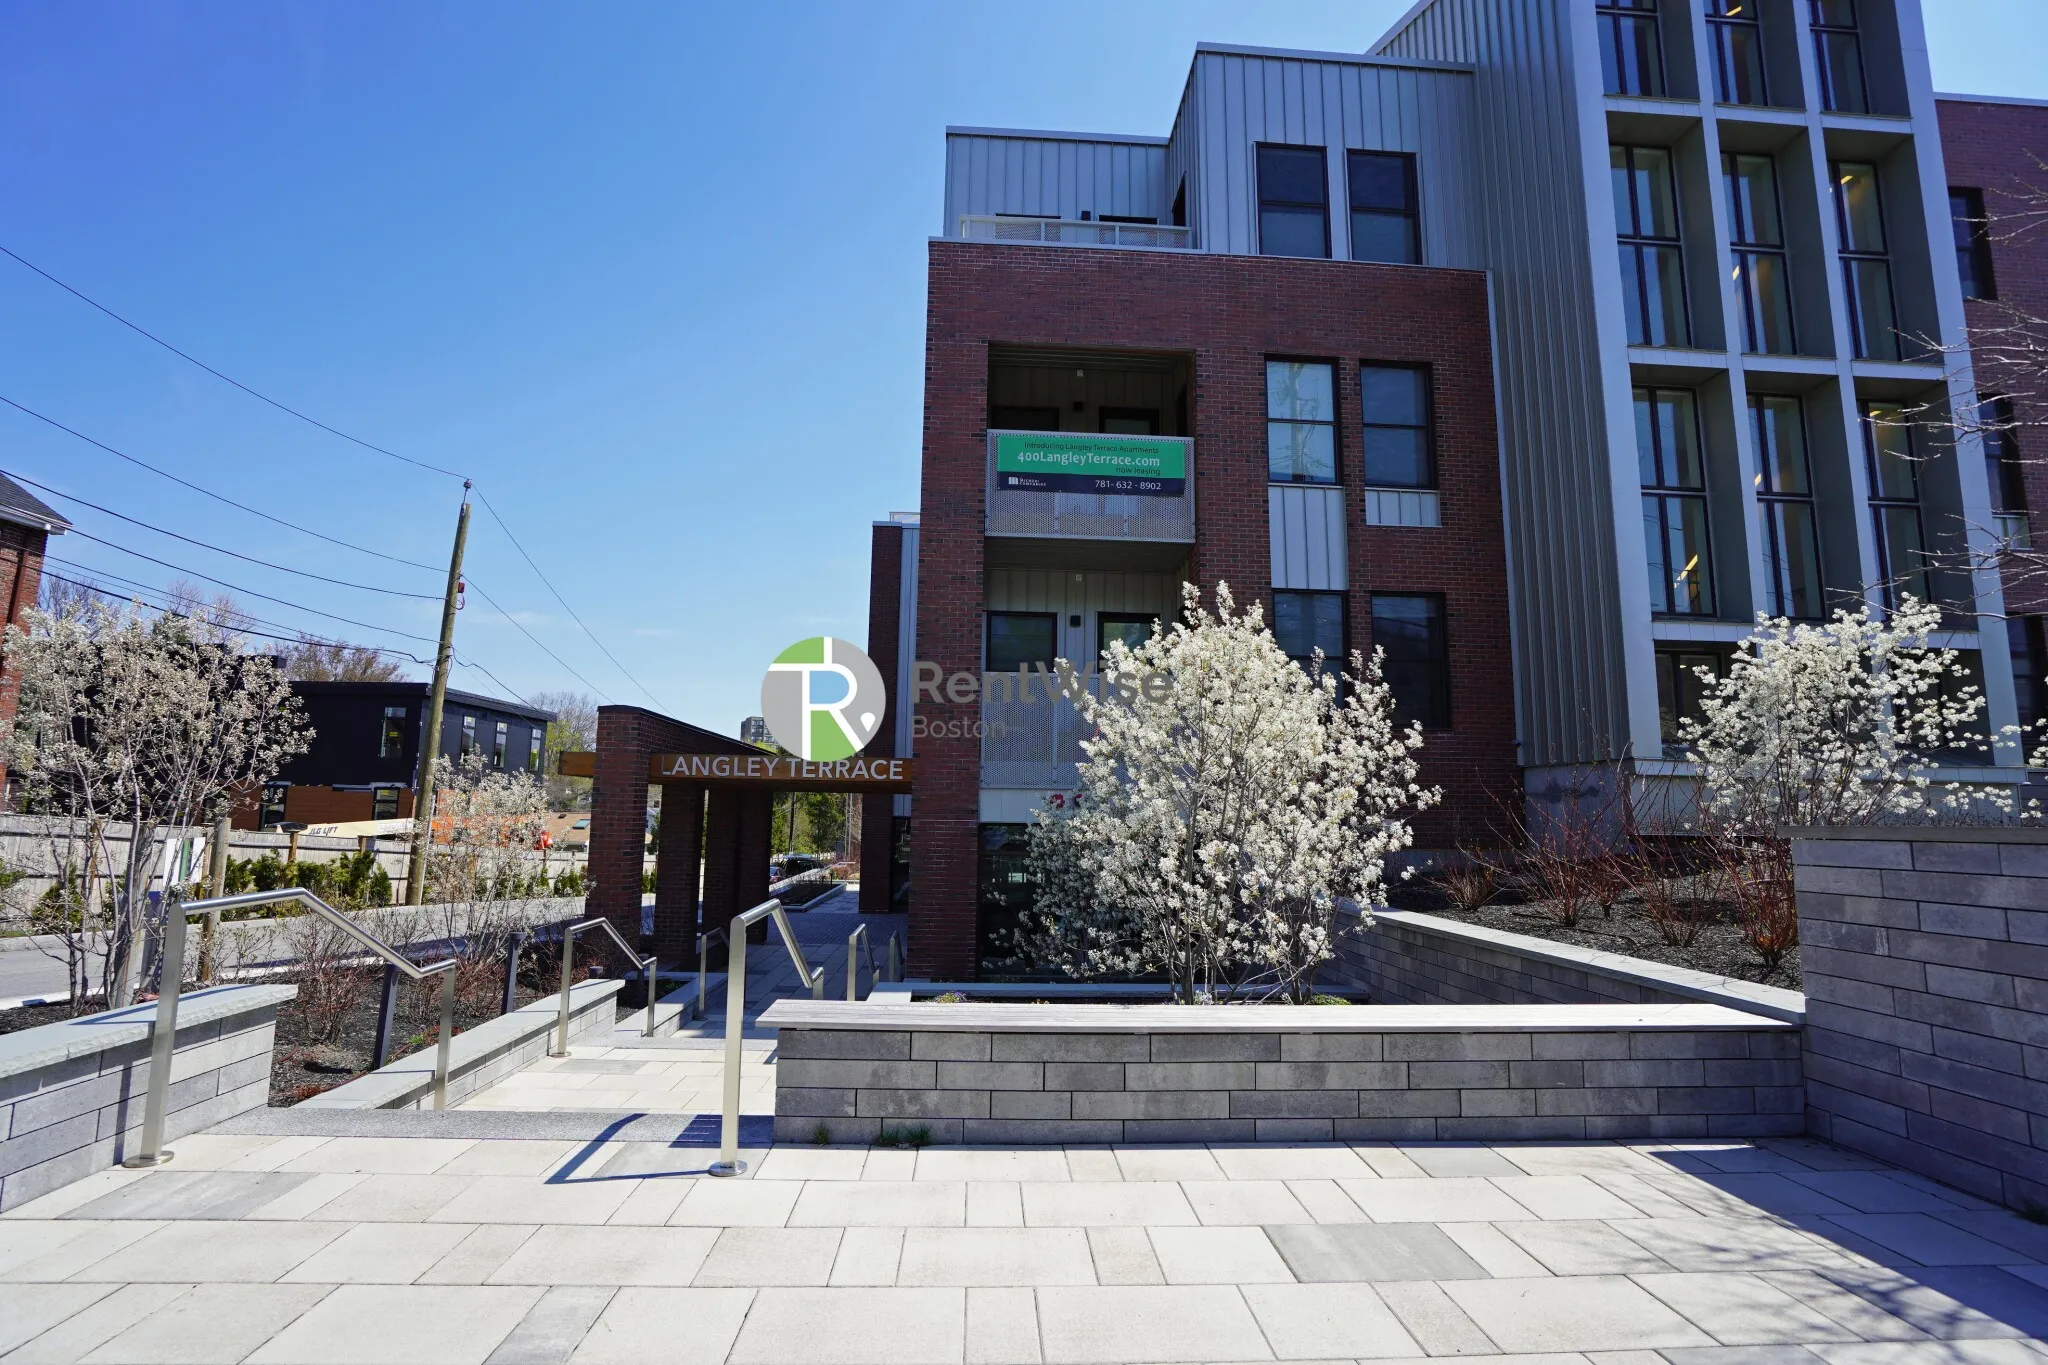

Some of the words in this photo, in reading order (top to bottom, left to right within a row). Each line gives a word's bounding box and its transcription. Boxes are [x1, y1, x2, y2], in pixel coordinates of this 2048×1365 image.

[1024, 442, 1064, 450] Introducing
[1065, 443, 1092, 452] Langley
[1120, 446, 1159, 454] Apartments
[1017, 451, 1160, 466] 400LangleyTerrace.com
[1134, 467, 1161, 476] leasing
[786, 758, 903, 780] TERRACE
